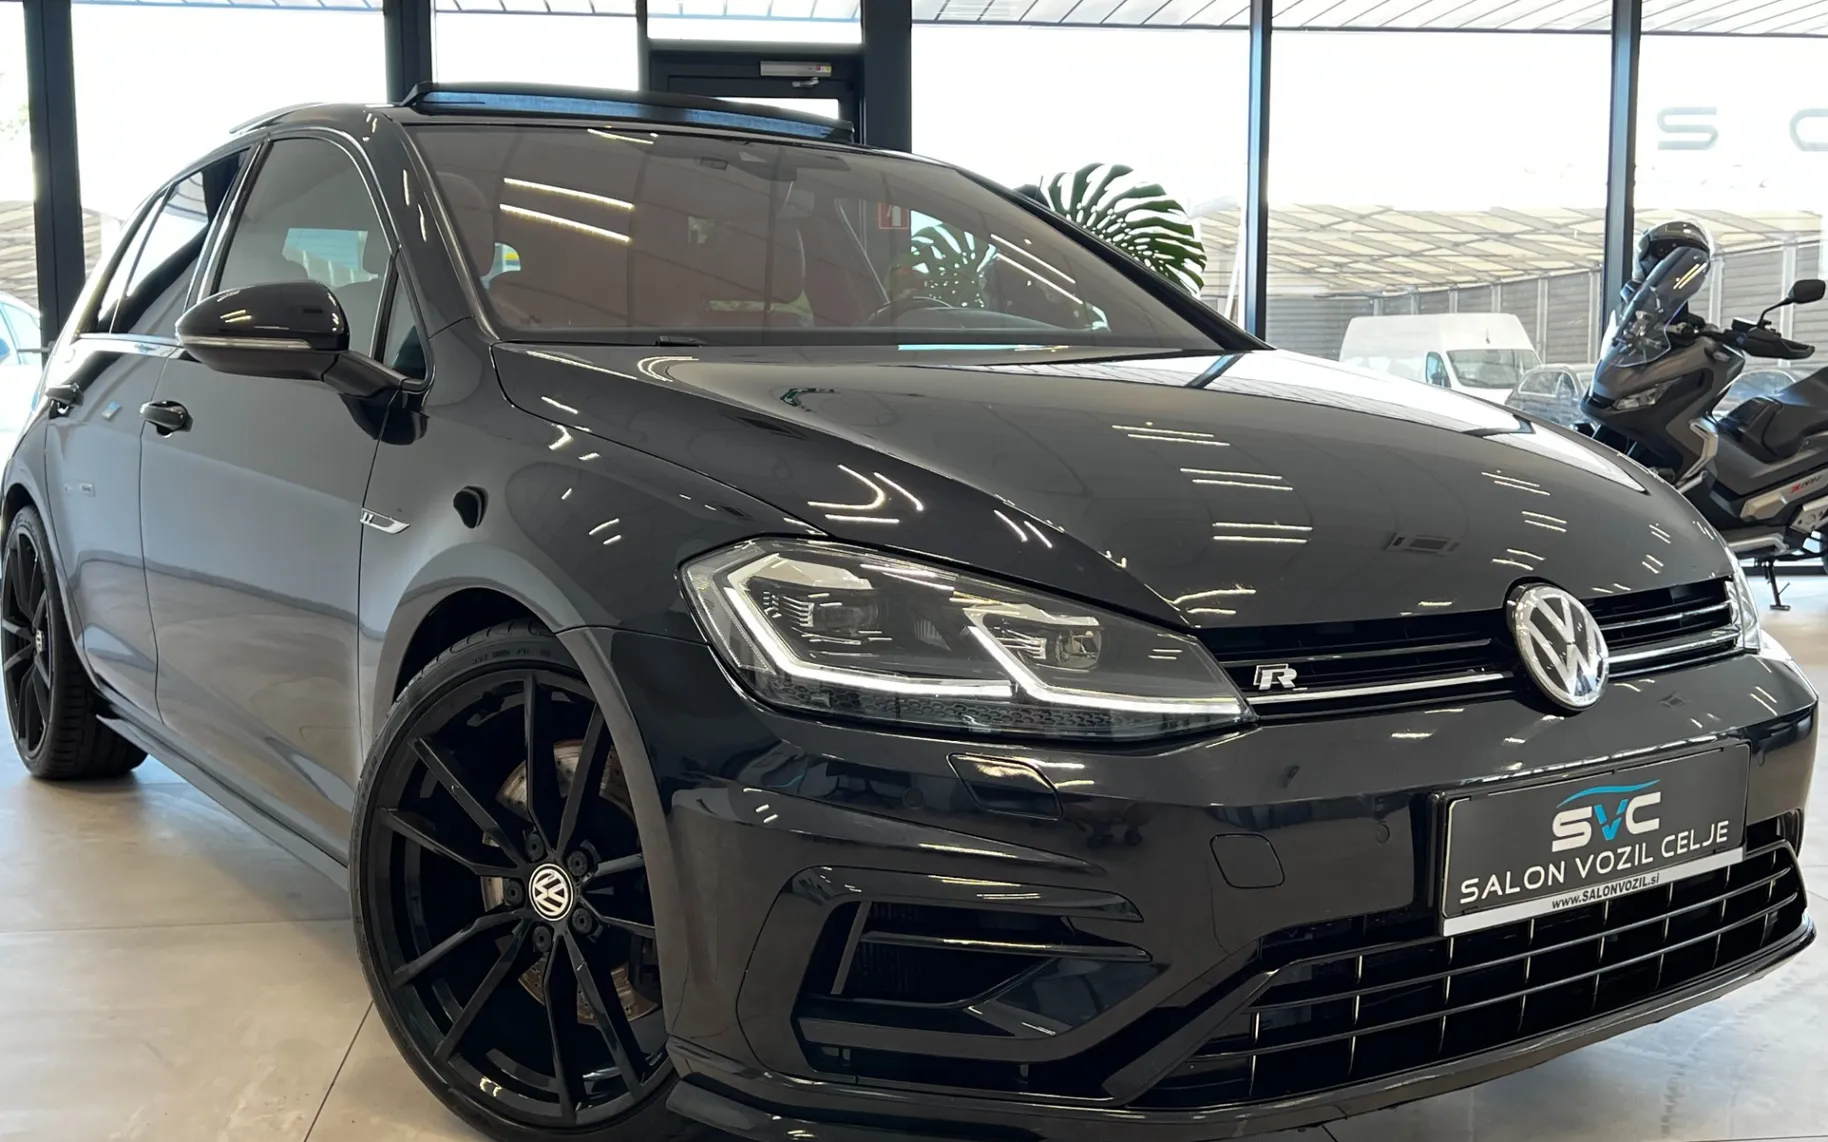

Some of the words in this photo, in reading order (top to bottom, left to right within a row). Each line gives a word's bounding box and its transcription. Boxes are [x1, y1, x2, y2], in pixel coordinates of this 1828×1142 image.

[1253, 663, 1298, 690] R
[1551, 791, 1661, 852] SVC
[1459, 860, 1565, 904] SALON
[1575, 842, 1654, 879] VOZIL
[1660, 820, 1730, 858] CELJE
[1551, 872, 1660, 909] www.SALONVOZIL.si
